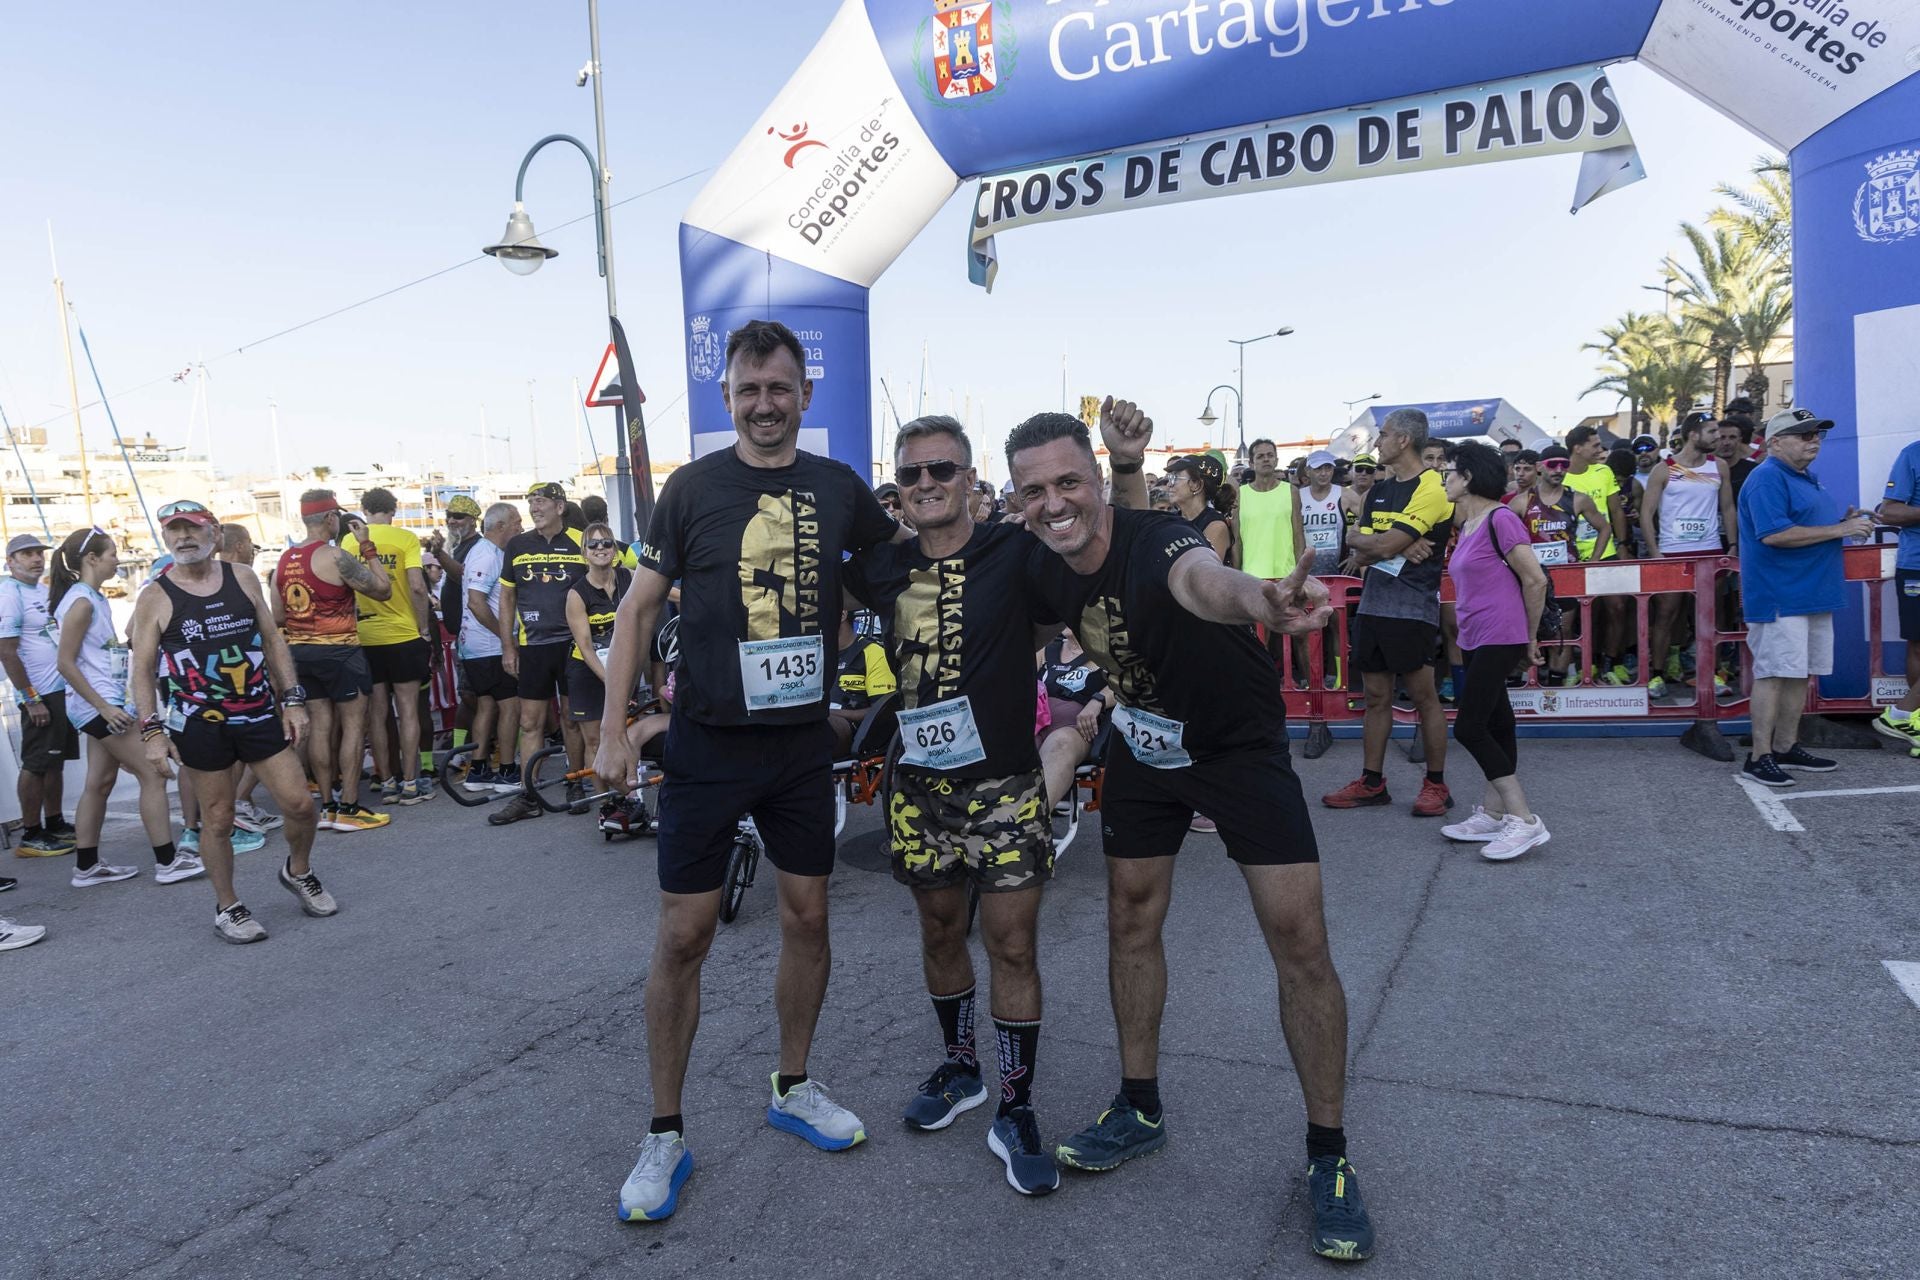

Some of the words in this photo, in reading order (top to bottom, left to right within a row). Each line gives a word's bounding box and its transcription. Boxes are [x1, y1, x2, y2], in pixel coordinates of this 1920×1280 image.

[1049, 0, 1456, 81] Cartage
[1851, 20, 1887, 48] de
[1764, 42, 1778, 54] DE
[1780, 53, 1838, 92] CARTAGENA
[975, 161, 1105, 229] CROSS
[1124, 149, 1181, 199] DE
[1200, 124, 1335, 187] CABO
[1358, 108, 1421, 166] DE
[1444, 75, 1621, 154] PALOS
[788, 145, 861, 229] Concejalía
[860, 118, 882, 143] de
[799, 131, 899, 246] Deportes
[1303, 513, 1337, 526] UNED
[1680, 522, 1706, 532] 1095
[1313, 532, 1330, 542] 327
[1540, 549, 1560, 558] 726
[760, 653, 816, 681] 1435
[1565, 697, 1644, 709] Infraestructuras
[916, 721, 956, 748] 626
[1003, 1029, 1013, 1072] TRAIL
